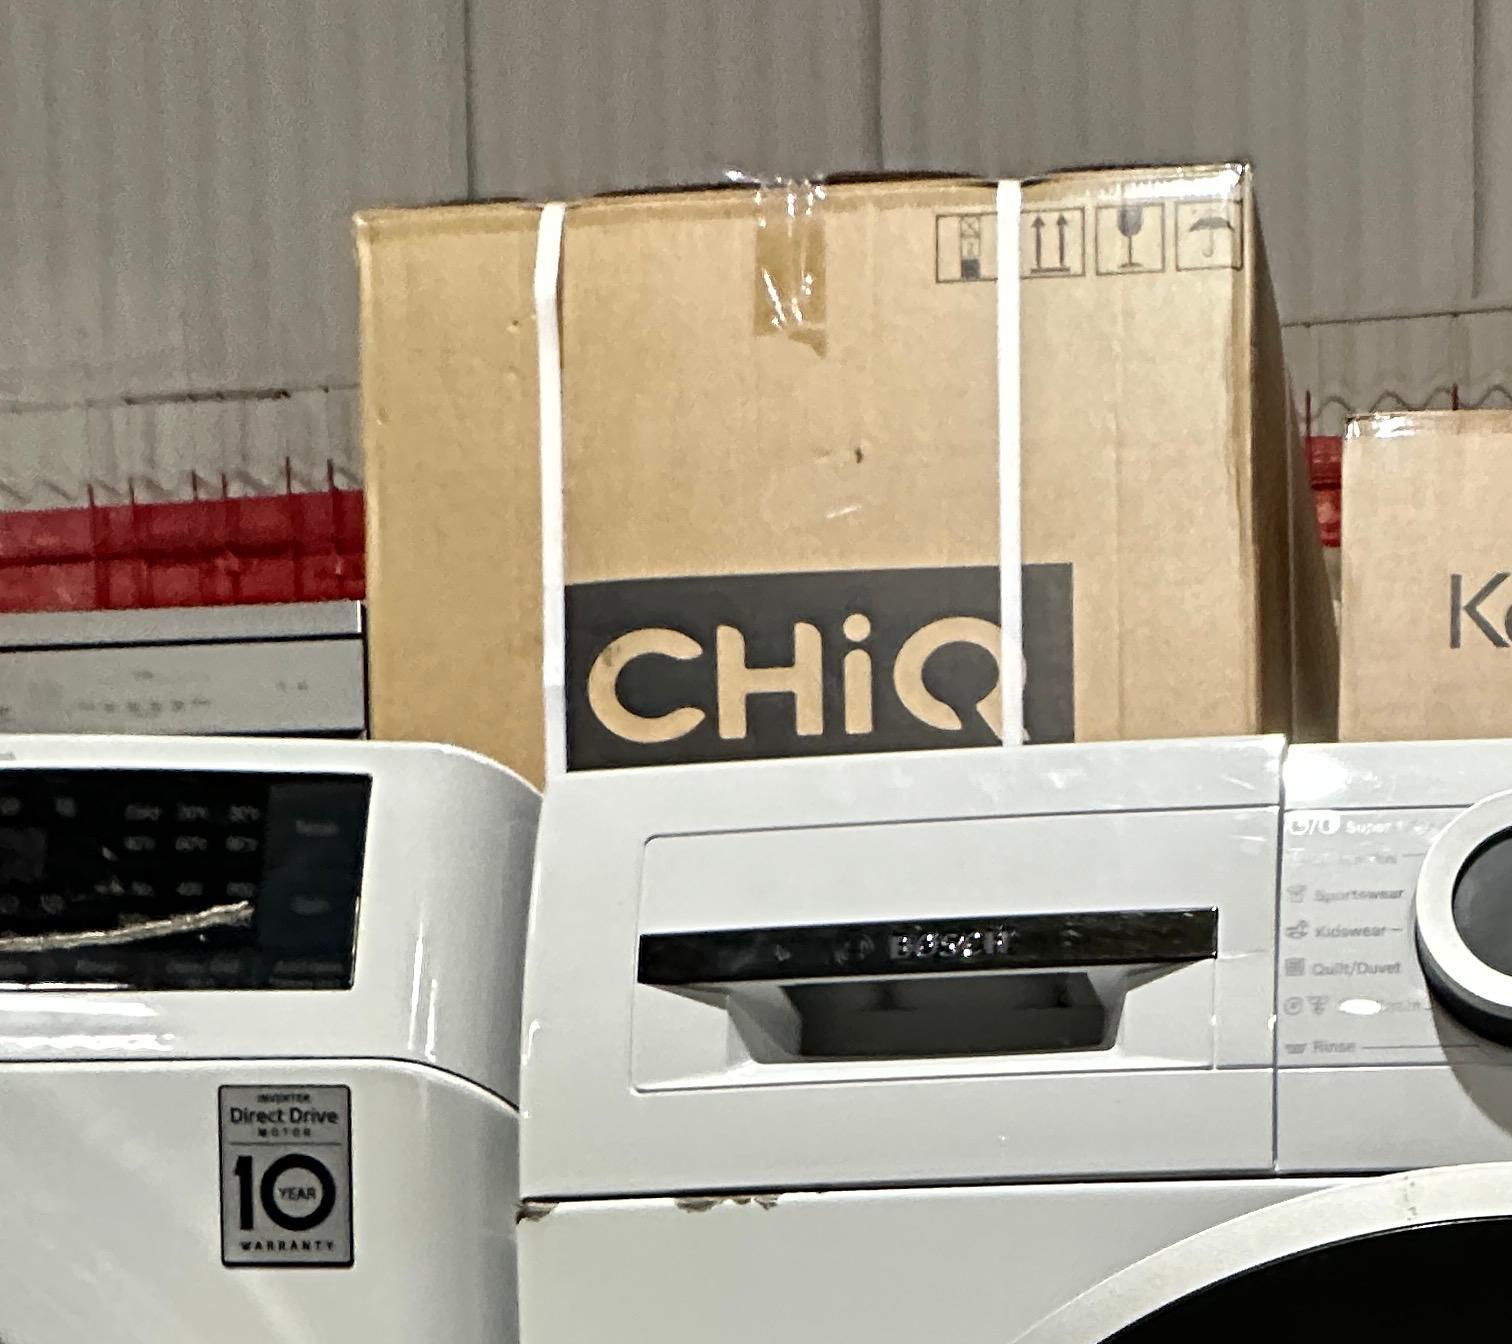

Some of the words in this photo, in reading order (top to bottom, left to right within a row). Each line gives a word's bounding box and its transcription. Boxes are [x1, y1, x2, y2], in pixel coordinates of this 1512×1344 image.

[588, 613, 1029, 743] CHiQ
[230, 1107, 285, 1124] Direct
[290, 1107, 339, 1124] Drive
[258, 1128, 311, 1137] MOTOR
[234, 1153, 336, 1231] 10
[279, 1187, 317, 1200] YEAR
[241, 1240, 334, 1251] WARRANTY
